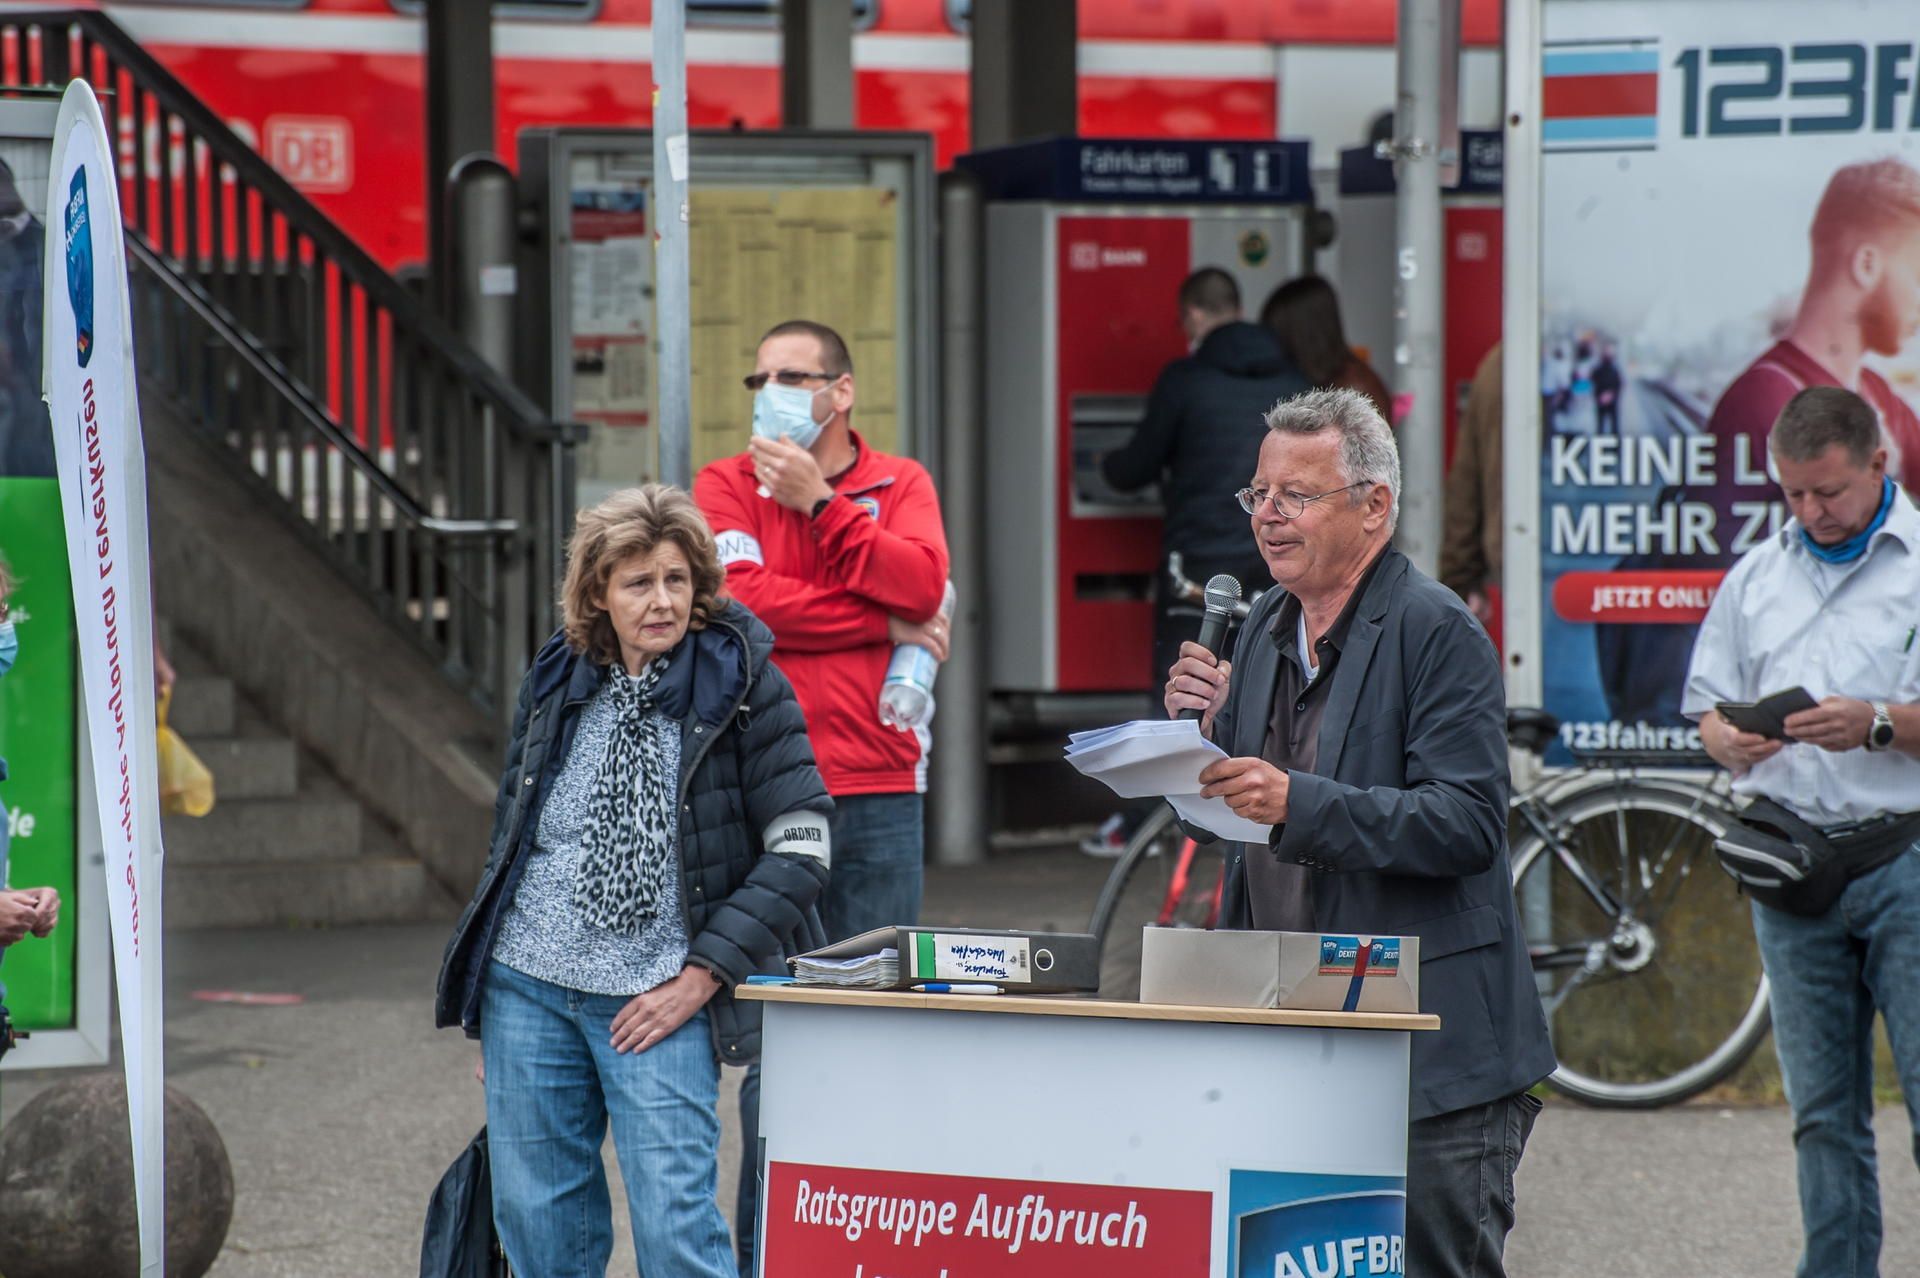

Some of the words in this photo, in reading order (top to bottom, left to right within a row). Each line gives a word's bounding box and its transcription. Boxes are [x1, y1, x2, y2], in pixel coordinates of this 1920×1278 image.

[1673, 42, 1920, 138] 123F
[284, 136, 332, 172] DB
[1080, 146, 1188, 175] Fahrkarten
[1551, 434, 1718, 486] KEINE
[1551, 503, 1721, 555] MEHR
[1591, 586, 1654, 613] JETZT
[784, 826, 822, 842] ORDNER
[794, 1179, 958, 1247] Ratsgruppe
[964, 1192, 1149, 1254] Aufbruch
[1274, 1235, 1405, 1278] AUFBR
